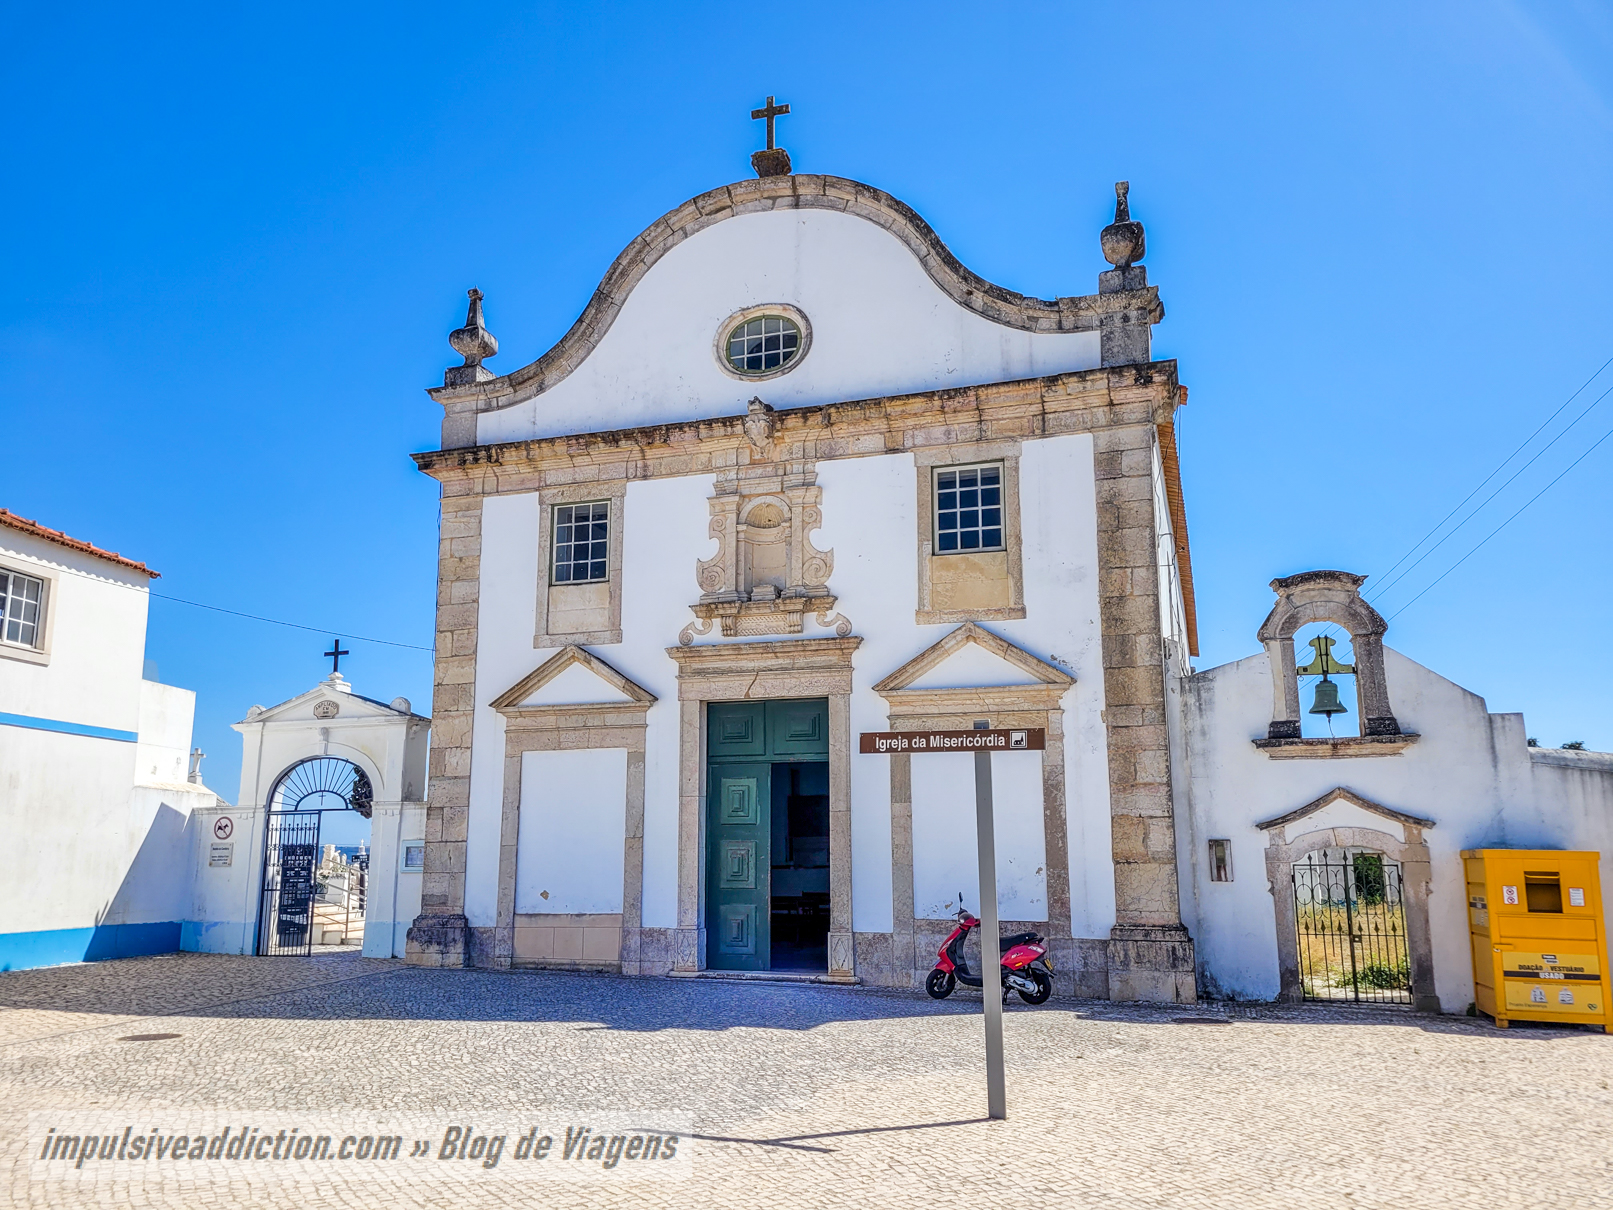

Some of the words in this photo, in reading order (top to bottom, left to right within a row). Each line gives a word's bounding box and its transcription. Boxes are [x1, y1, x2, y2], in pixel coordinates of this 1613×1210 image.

[875, 736, 909, 752] Igreja
[911, 736, 927, 748] da
[929, 734, 1006, 748] Misericórdia
[1518, 964, 1543, 972] DOAÇÃO
